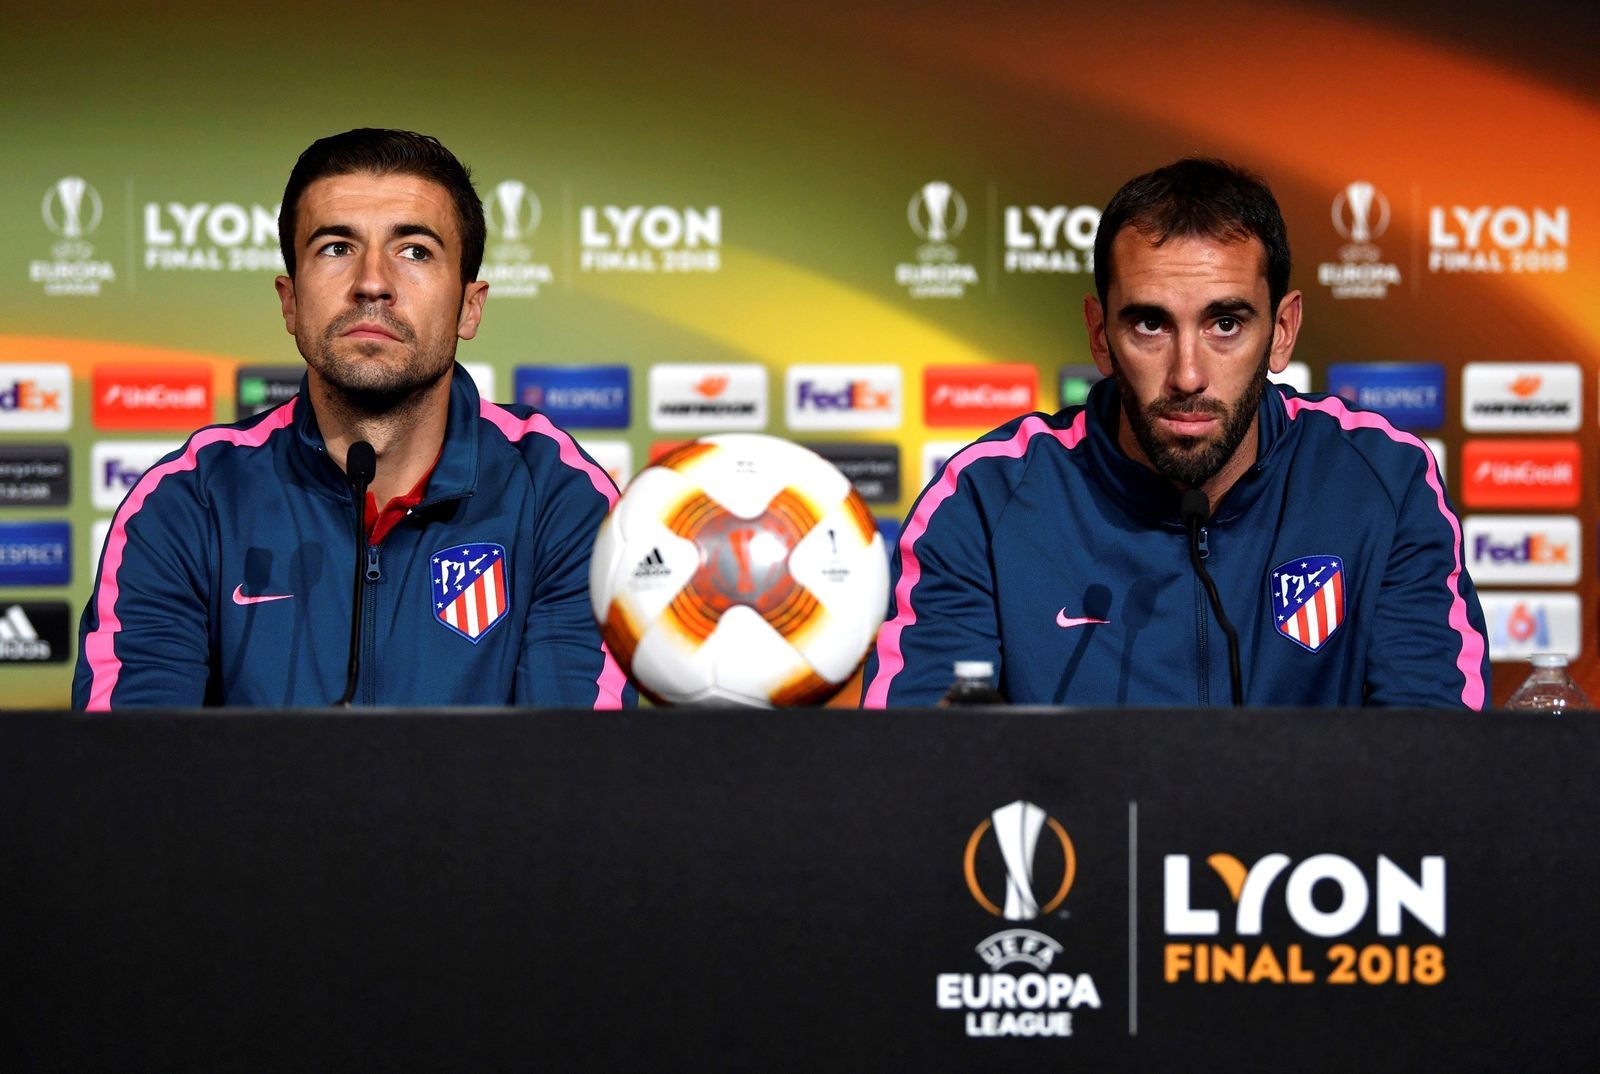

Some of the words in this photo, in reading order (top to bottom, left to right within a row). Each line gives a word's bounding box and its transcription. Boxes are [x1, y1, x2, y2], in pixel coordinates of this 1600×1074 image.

[145, 203, 282, 246] LYON
[580, 206, 722, 248] LYON
[1005, 206, 1100, 250] LYO
[1429, 206, 1568, 249] LYON
[145, 249, 220, 270] FINAL
[581, 251, 656, 272] FINAL
[661, 251, 721, 272] 2018
[1005, 252, 1080, 273] FINAL
[1429, 252, 1502, 273] FINAL
[1510, 252, 1568, 273] 2018
[0, 379, 61, 413] dEx
[797, 380, 893, 412] FedEx
[0, 543, 64, 565] ESPECT
[1475, 534, 1568, 564] FedEx
[1164, 853, 1446, 938] LYON
[979, 936, 1056, 967] UEFA
[1164, 944, 1315, 984] FINAL
[1327, 944, 1446, 985] 2018
[936, 973, 1101, 1009] EUROPA
[965, 1011, 1073, 1037] LEAGUE
